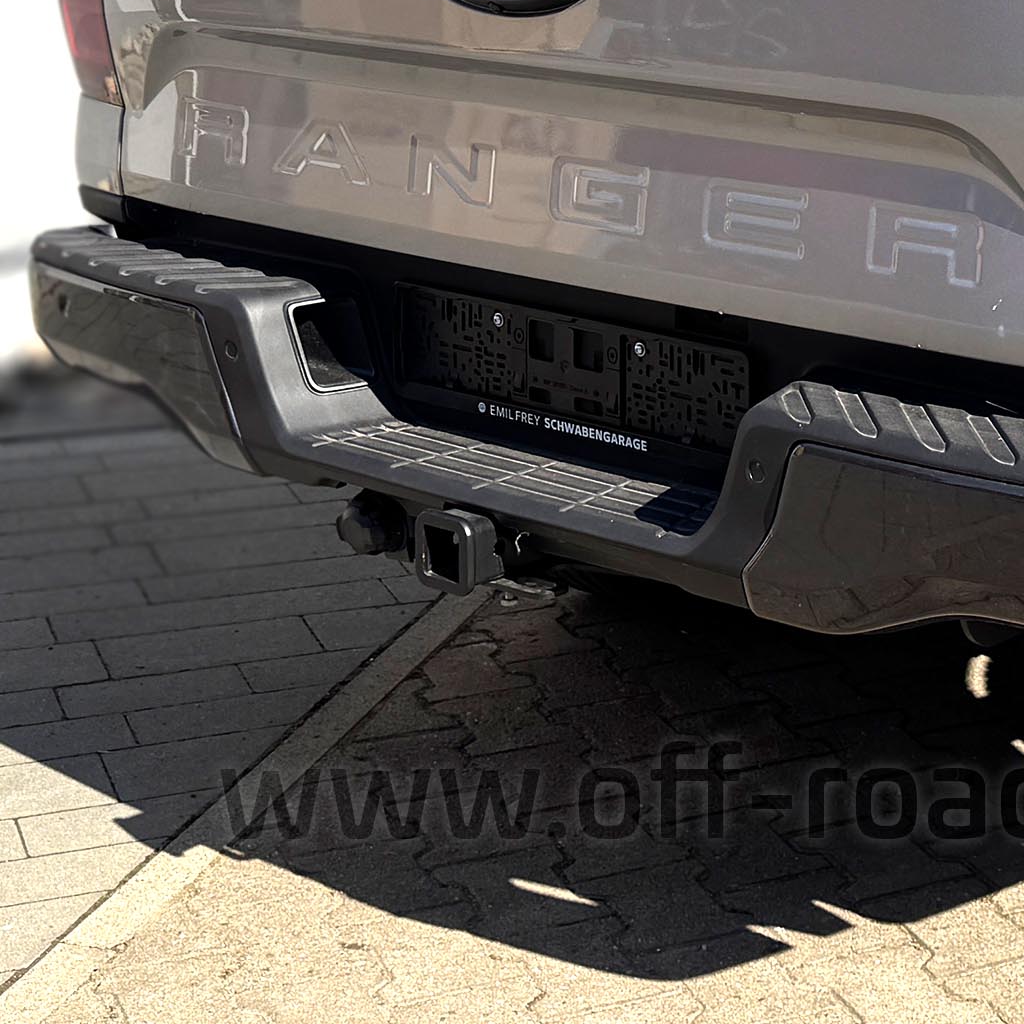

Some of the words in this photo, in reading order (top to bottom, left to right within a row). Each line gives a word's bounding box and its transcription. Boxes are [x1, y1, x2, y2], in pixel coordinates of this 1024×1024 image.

[174, 96, 986, 289] RANGER
[490, 404, 514, 420] EMIL
[515, 409, 541, 426] FREY
[544, 417, 648, 452] SCHWABENGARAGE
